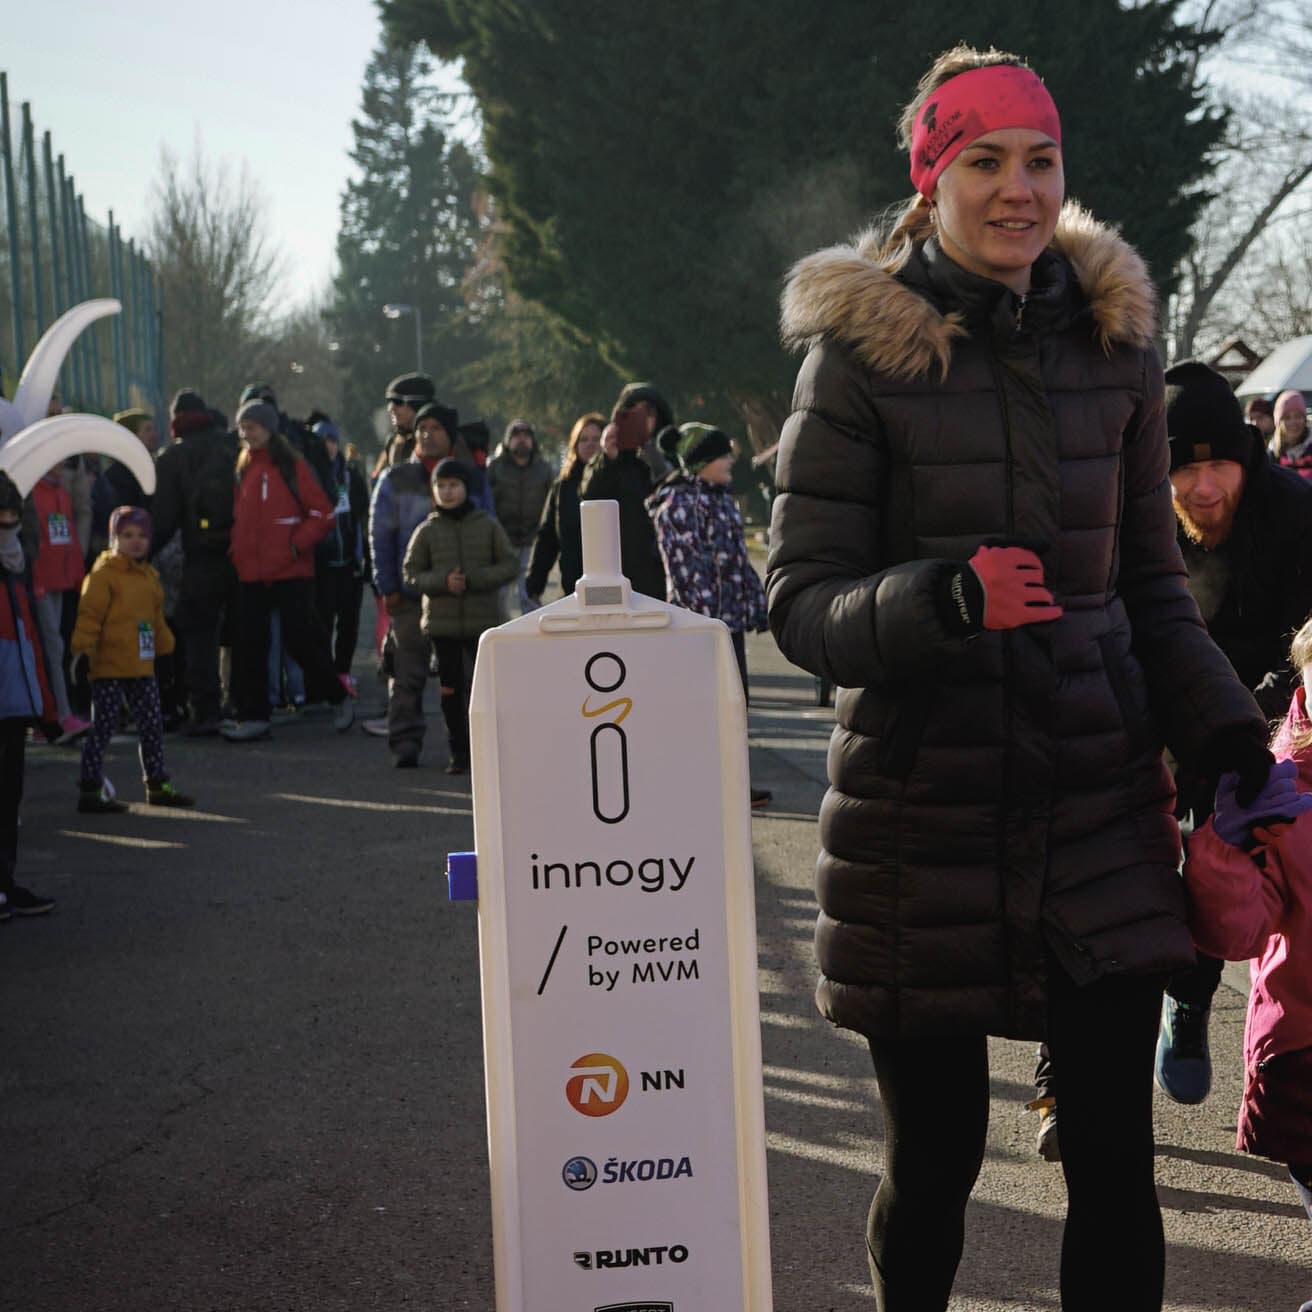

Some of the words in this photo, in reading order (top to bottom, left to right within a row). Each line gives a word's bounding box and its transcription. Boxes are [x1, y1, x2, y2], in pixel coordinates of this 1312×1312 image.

[531, 853, 696, 892] innogy
[587, 928, 700, 957] Powered
[588, 965, 620, 991] by
[631, 959, 700, 984] MVM
[640, 1068, 685, 1092] NN
[602, 1157, 694, 1184] ŠKODA
[596, 1244, 689, 1269] RUNTO
